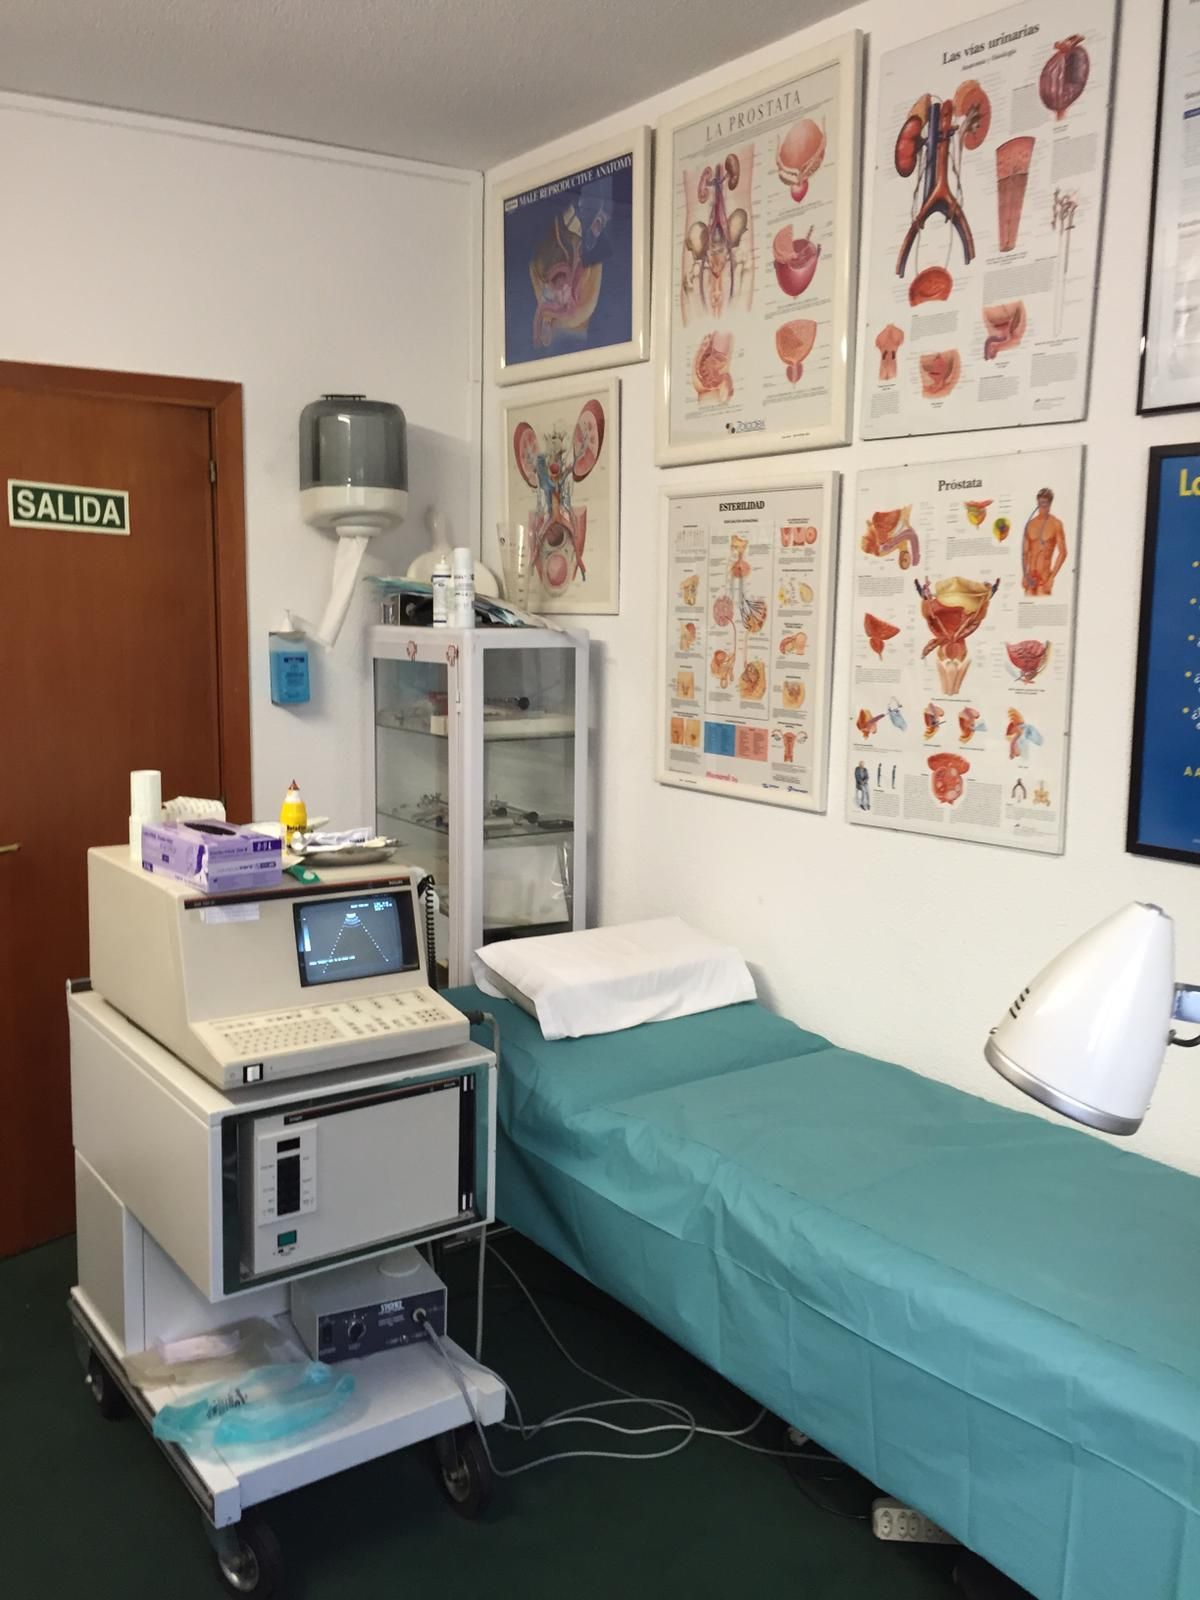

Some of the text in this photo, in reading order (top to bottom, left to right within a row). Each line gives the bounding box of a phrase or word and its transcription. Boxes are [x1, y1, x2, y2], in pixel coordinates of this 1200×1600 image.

[942, 51, 961, 65] Las
[988, 24, 1040, 49] urinarias
[706, 89, 801, 142] LA PROSTATA
[519, 155, 632, 206] MALE REPRODUCTIVE ANATOMY
[938, 477, 983, 492] Próstata
[17, 488, 121, 526] SALIDA
[719, 500, 765, 512] ESTERILIDAD
